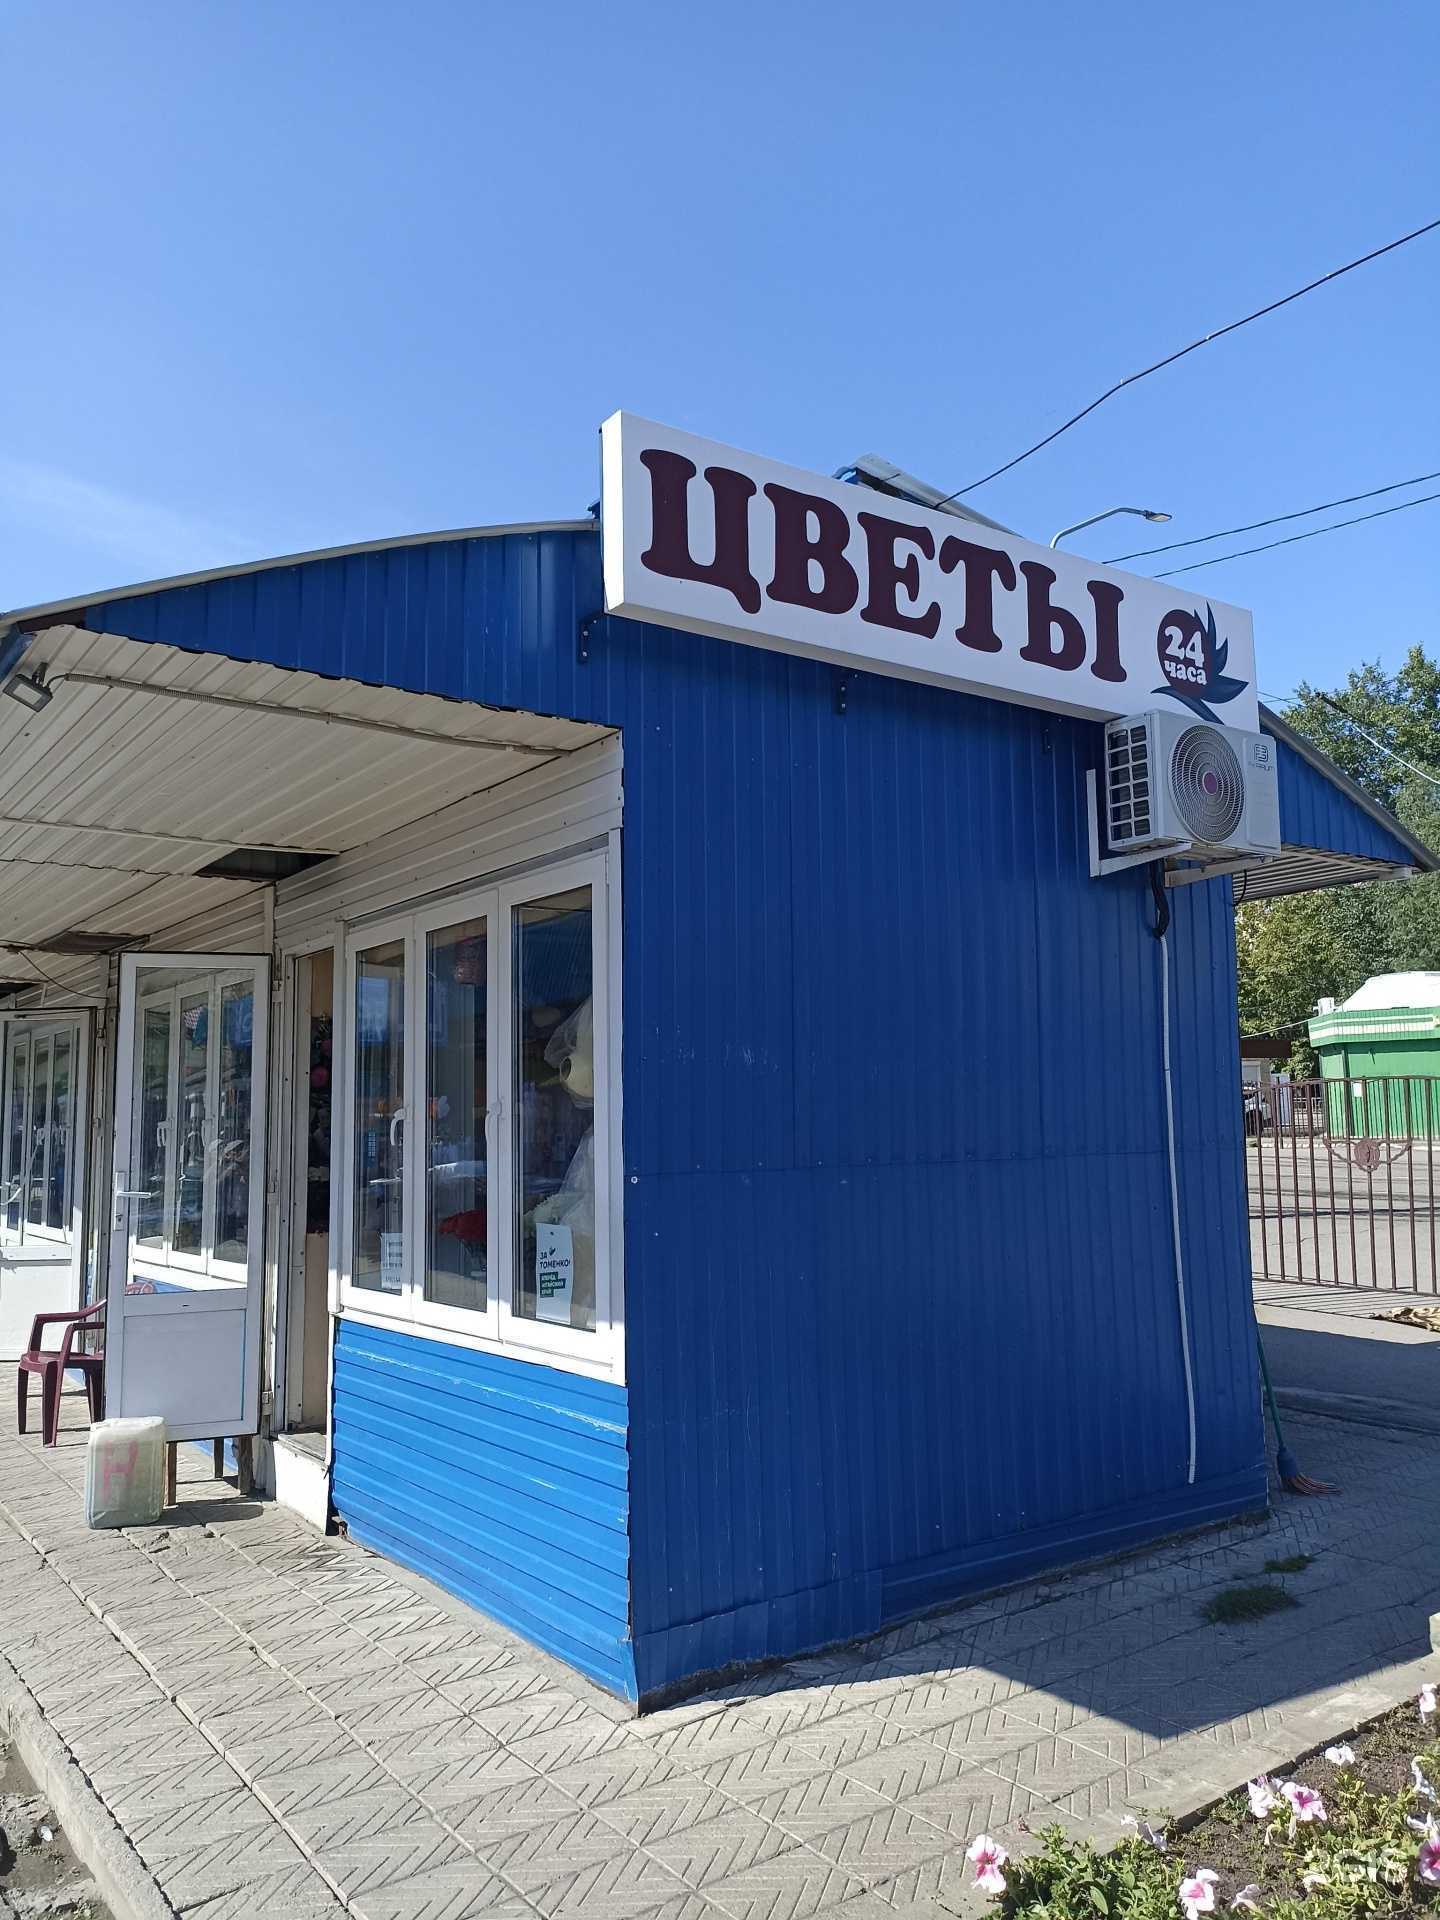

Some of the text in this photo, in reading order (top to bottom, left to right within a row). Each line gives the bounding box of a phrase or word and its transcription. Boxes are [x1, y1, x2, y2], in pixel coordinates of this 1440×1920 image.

[640, 448, 1127, 682] ЦВЕТЫ
[1164, 625, 1205, 668] 24
[1163, 660, 1208, 686] часа
